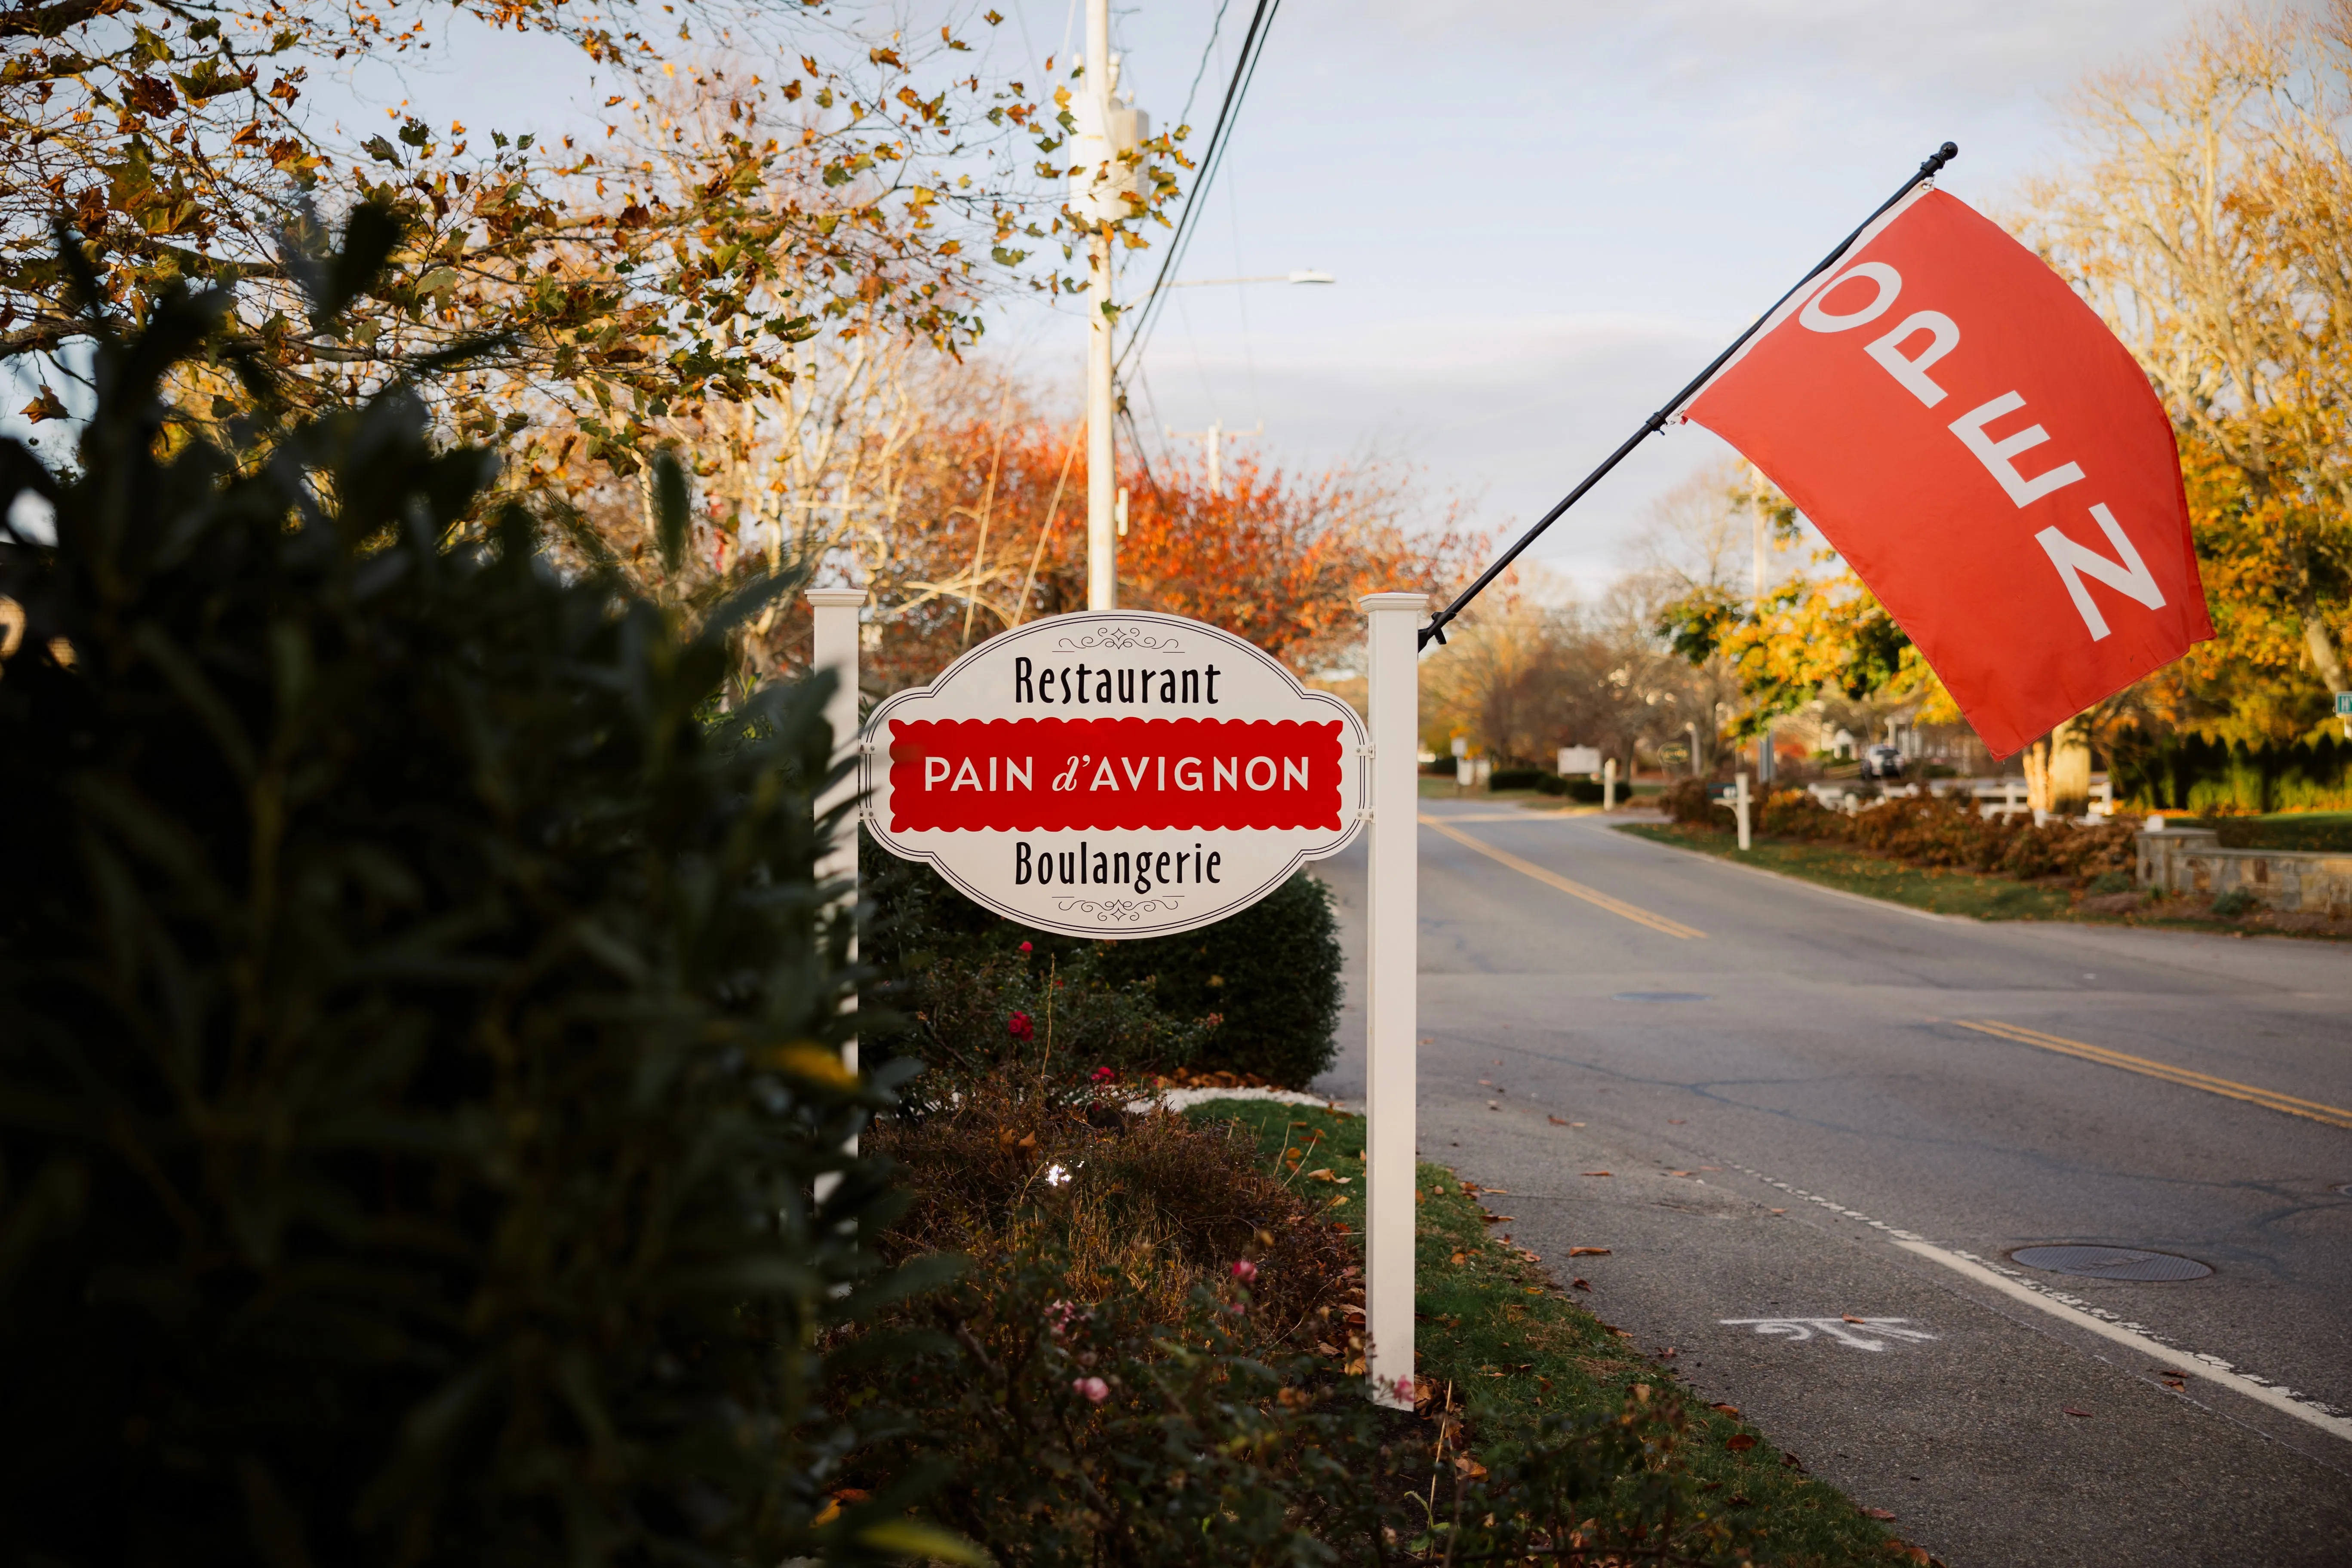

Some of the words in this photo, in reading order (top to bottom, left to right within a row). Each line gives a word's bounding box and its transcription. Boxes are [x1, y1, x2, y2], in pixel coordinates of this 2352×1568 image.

[1799, 261, 2166, 642] OPEN
[1015, 657, 1221, 704] Restaurant
[925, 756, 1033, 791] PAIN
[1052, 755, 1309, 791] d'AVIGNON
[1015, 841, 1221, 895] Boulangerie
